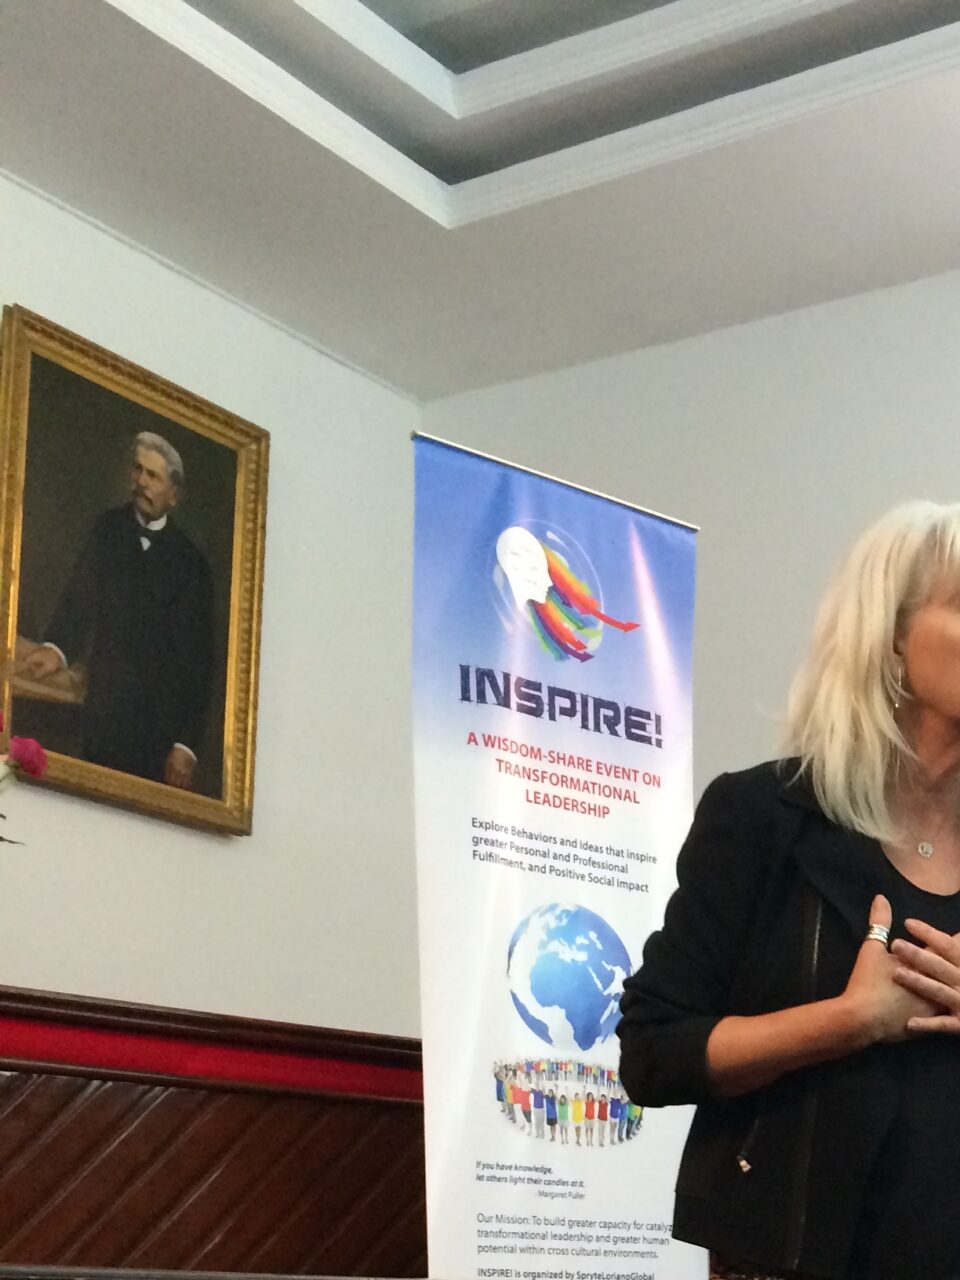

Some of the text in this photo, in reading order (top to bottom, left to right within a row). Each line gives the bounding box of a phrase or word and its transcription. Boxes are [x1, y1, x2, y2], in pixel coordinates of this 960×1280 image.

[459, 664, 663, 748] INSPIRE!
[467, 732, 661, 788] A WISDOM-SHARE EVENT ON
[496, 759, 640, 804] TRANSFORMATIONAL
[525, 789, 610, 819] LEADERSHIP
[471, 817, 509, 834] Explore
[511, 826, 557, 845] Behaviors
[560, 838, 577, 849] and
[605, 845, 625, 858] that
[626, 849, 657, 864] inspire
[472, 836, 628, 874] greater Personal and Professional
[472, 850, 649, 892] Fulfillment, and Positive Social Impact
[482, 1162, 494, 1170] you
[496, 1162, 513, 1171] have
[486, 1174, 507, 1183] others
[509, 1176, 526, 1185] light
[527, 1177, 542, 1185] their
[543, 1178, 569, 1187] candles
[477, 1213, 493, 1223] Our
[544, 1216, 566, 1227] build
[567, 1219, 597, 1230] greater
[598, 1220, 631, 1231] capacity
[633, 1221, 644, 1231] for
[646, 1222, 673, 1233] catalyz
[477, 1228, 670, 1245] transformational leadership and greater human
[477, 1244, 659, 1259] potential within cross cultural environments.
[514, 1269, 521, 1278] is
[522, 1269, 563, 1280] organized
[565, 1270, 575, 1280] by
